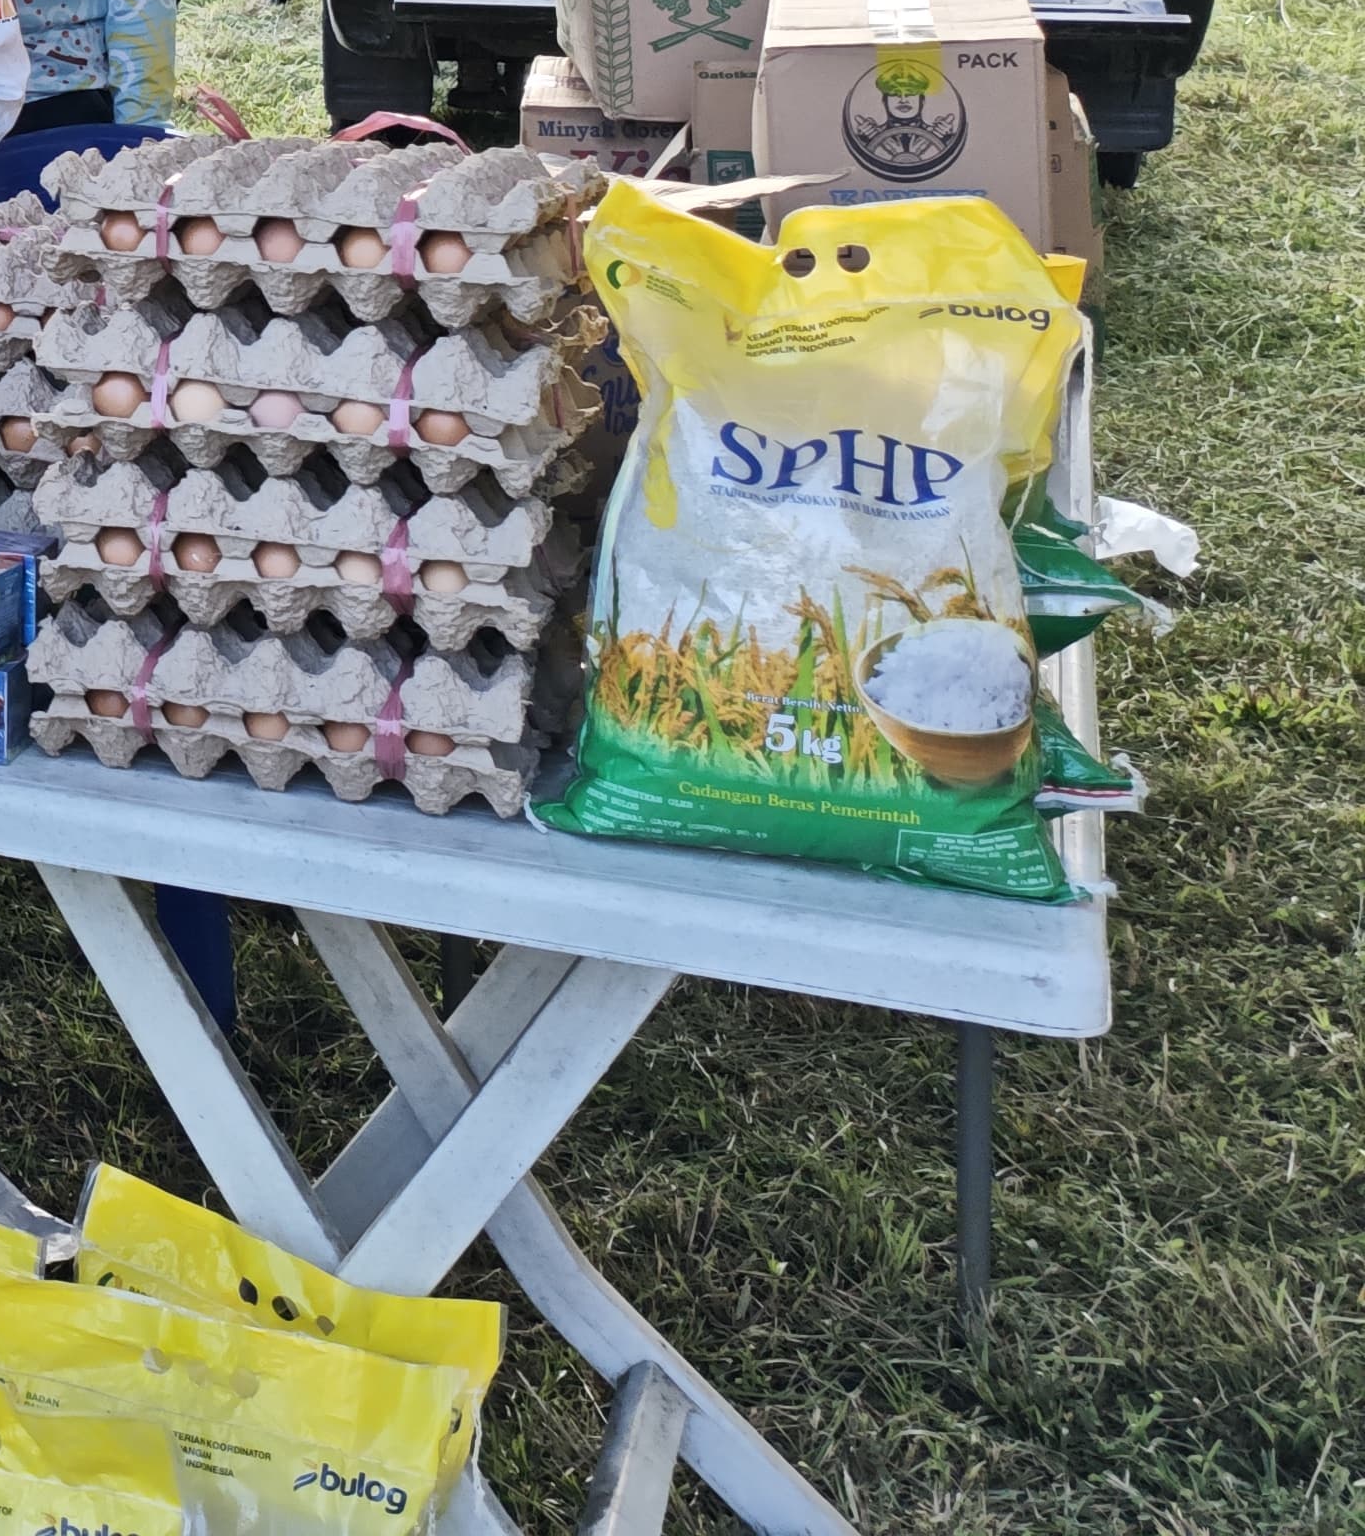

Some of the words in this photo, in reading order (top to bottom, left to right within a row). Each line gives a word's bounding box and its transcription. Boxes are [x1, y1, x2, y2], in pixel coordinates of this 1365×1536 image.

[957, 52, 1019, 69] PACK
[697, 71, 757, 80] Gatotka
[538, 121, 616, 142] Minyak
[621, 123, 677, 139] Gore
[746, 322, 816, 343] KEMENTERIAN
[785, 332, 829, 344] PANGAN
[745, 345, 797, 357] REPUBLIK
[799, 335, 855, 354] INDONESIA
[712, 421, 964, 506] SPHP
[781, 493, 837, 508] PASOKAN
[839, 497, 862, 510] DAN
[900, 506, 950, 521] PANGAN
[746, 690, 779, 705] Berat
[765, 713, 797, 752] 5
[802, 729, 843, 764] kg
[678, 780, 762, 805] Cadangan
[768, 793, 815, 812] Beras
[820, 801, 921, 825] Pemerintah
[25, 1391, 60, 1408] BADAN
[173, 1431, 205, 1446] TERIAN
[205, 1440, 271, 1461] KOORDINATOR
[186, 1459, 234, 1477] INDONESIA
[319, 1463, 408, 1515] bulog
